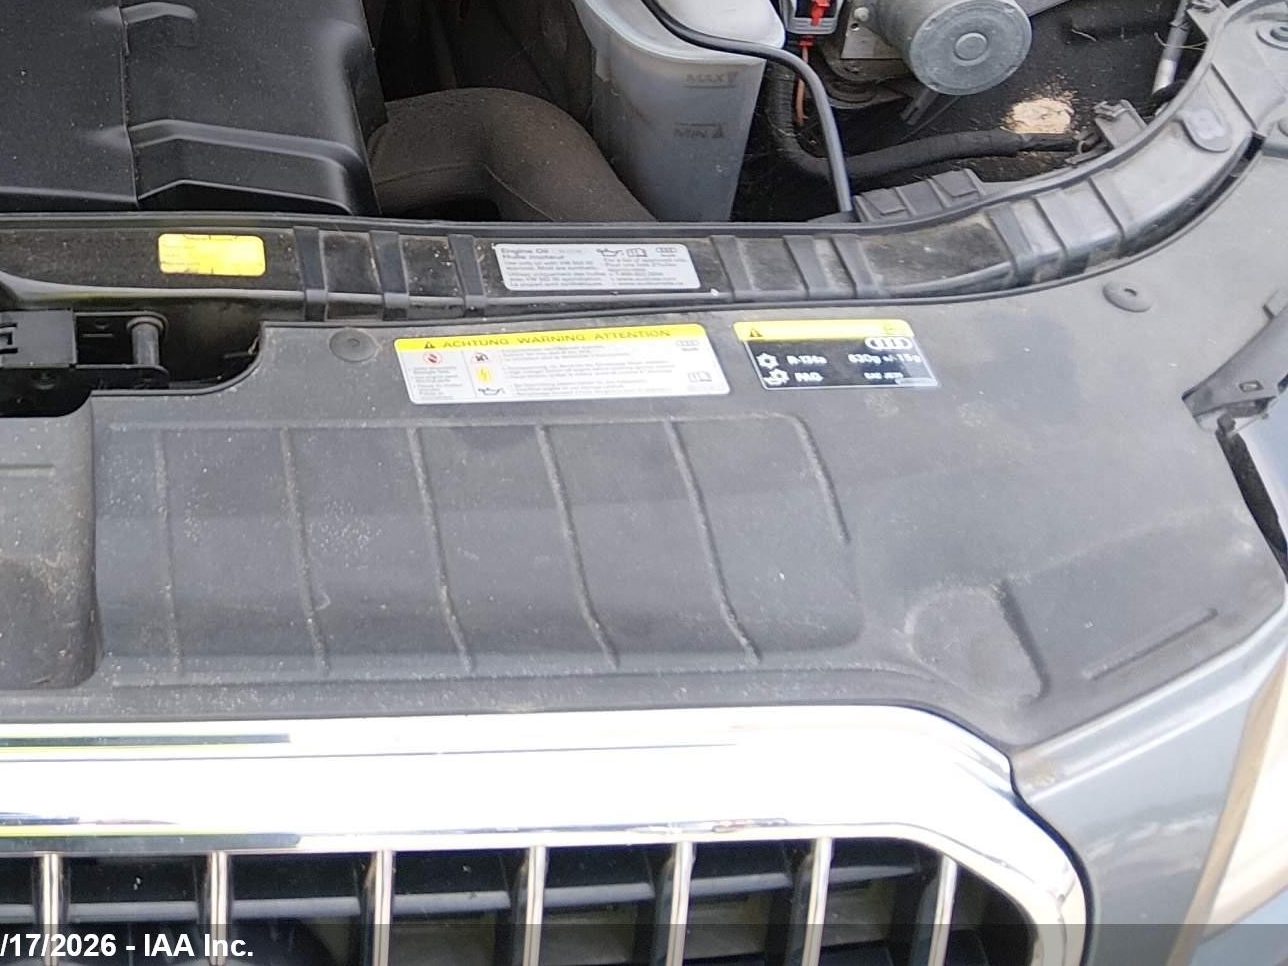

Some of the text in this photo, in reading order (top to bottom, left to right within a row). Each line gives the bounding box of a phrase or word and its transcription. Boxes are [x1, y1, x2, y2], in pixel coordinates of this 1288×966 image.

[686, 73, 725, 83] MAX
[442, 329, 671, 348] ACHTUNG WARNING ATTENTION
